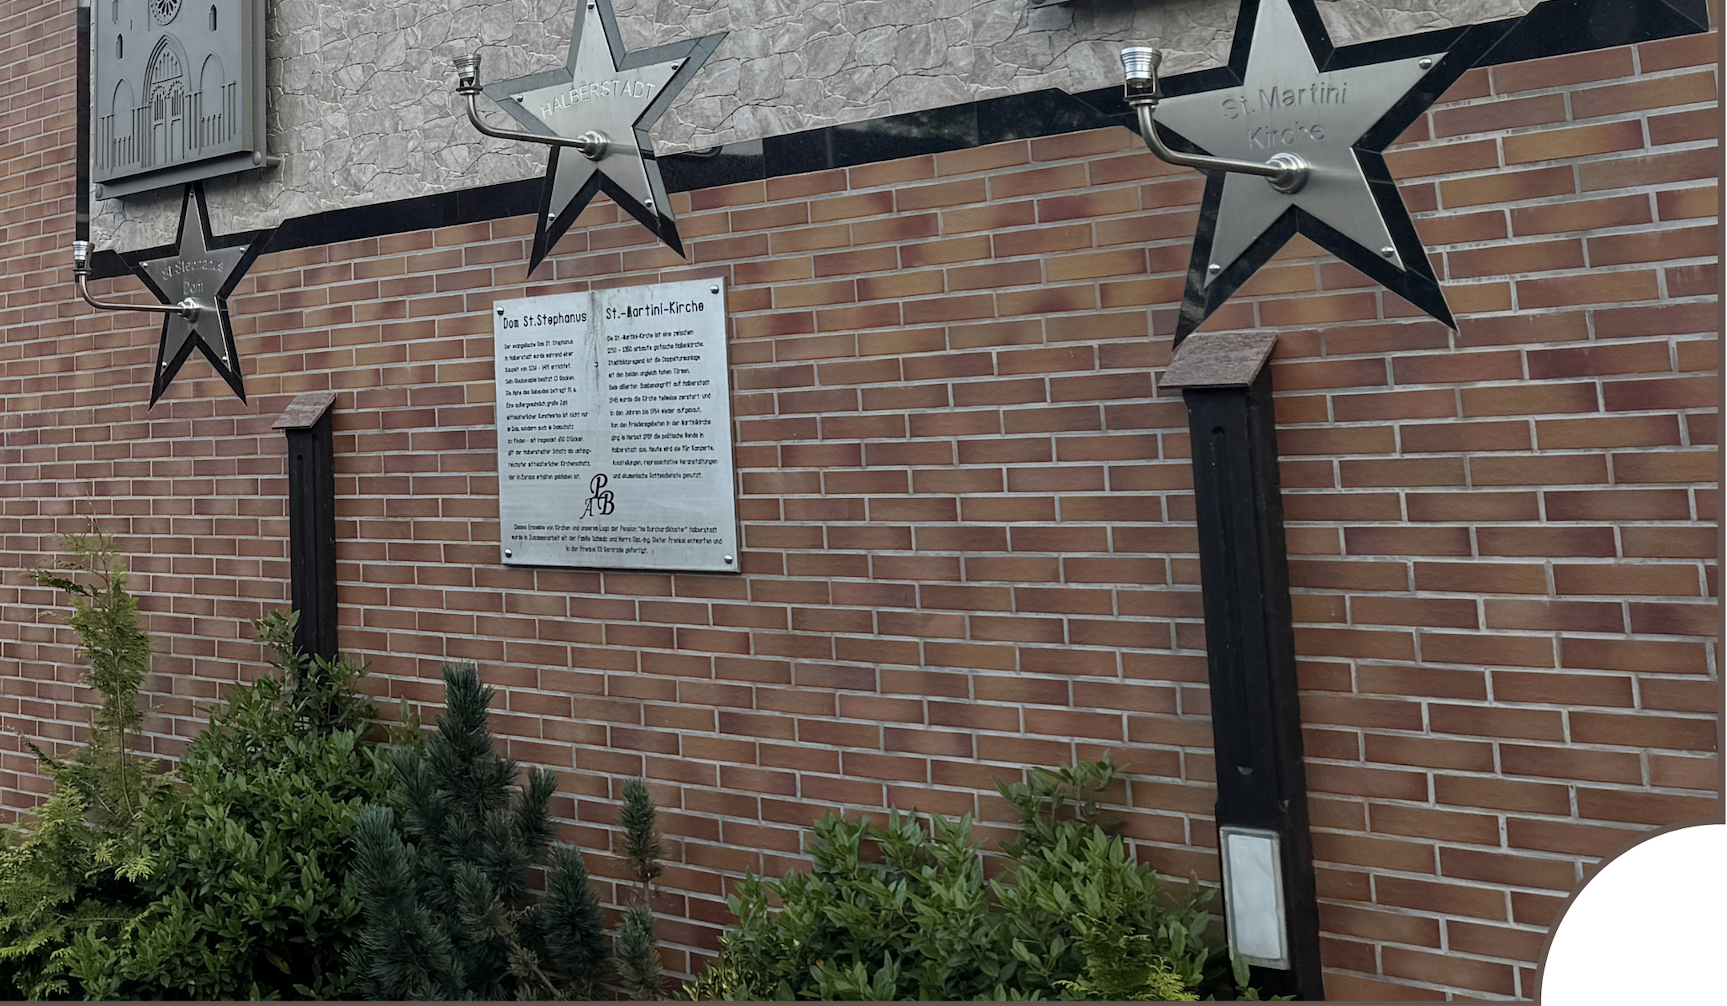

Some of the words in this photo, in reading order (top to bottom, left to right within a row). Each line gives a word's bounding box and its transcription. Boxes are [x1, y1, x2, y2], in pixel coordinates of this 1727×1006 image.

[540, 79, 656, 120] HALBERSTADT
[1247, 121, 1325, 151] Kirche
[605, 300, 704, 320] St.-Martini-Kirche
[504, 317, 519, 330] Dom
